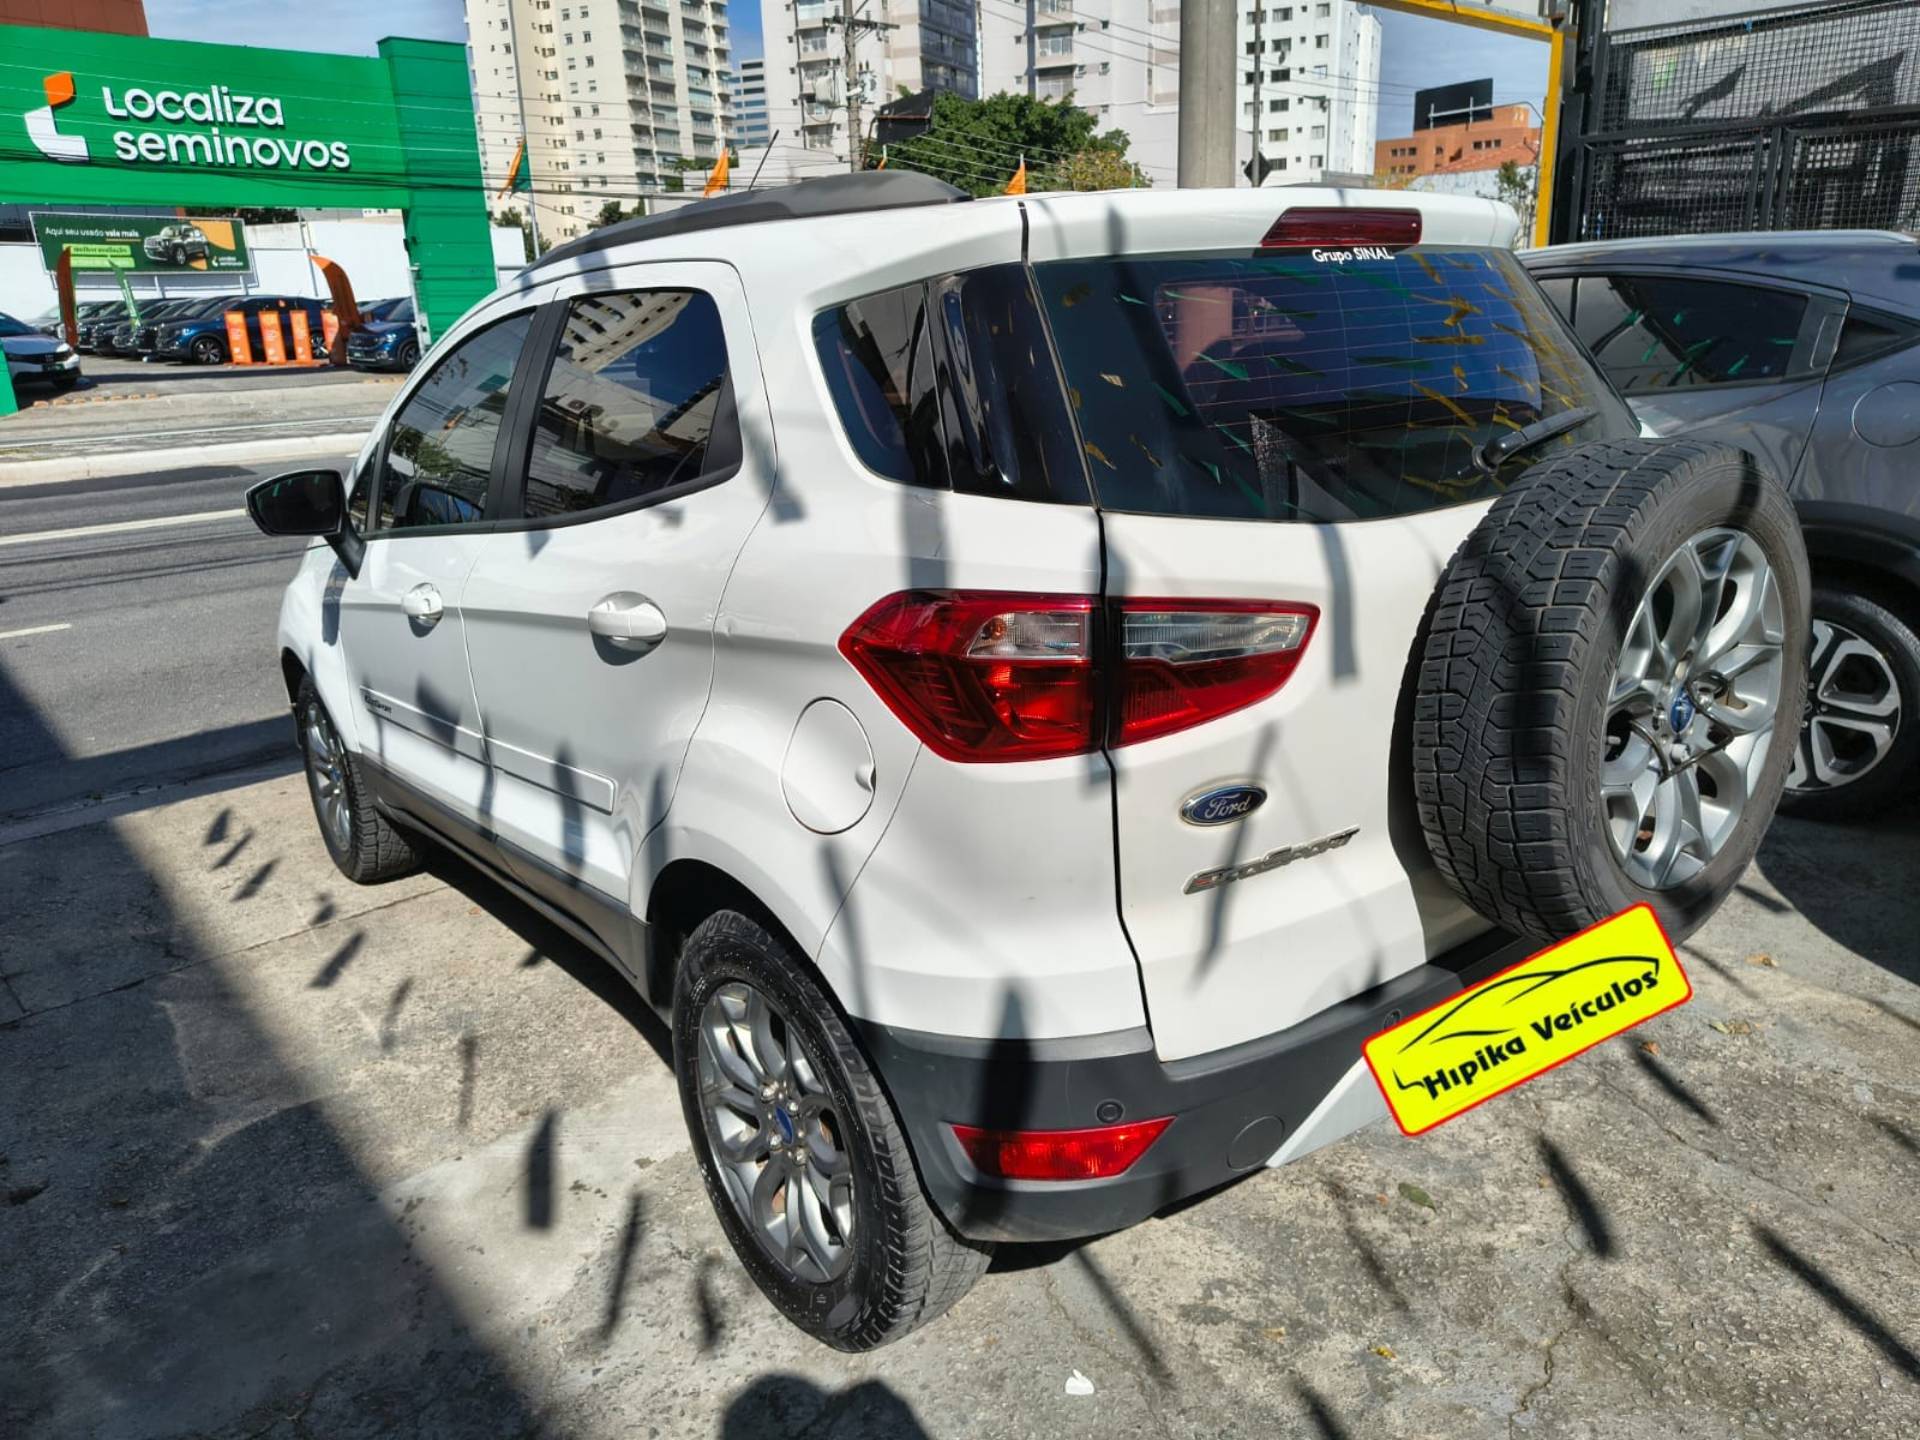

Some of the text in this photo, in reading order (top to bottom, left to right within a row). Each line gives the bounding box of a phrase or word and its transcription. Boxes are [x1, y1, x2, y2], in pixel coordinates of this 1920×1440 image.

[102, 84, 286, 128] Localiza
[113, 126, 351, 168] seminovos
[45, 227, 63, 236] Aqui
[1312, 247, 1395, 264] Grupo SINAL
[1205, 793, 1251, 819] Ford
